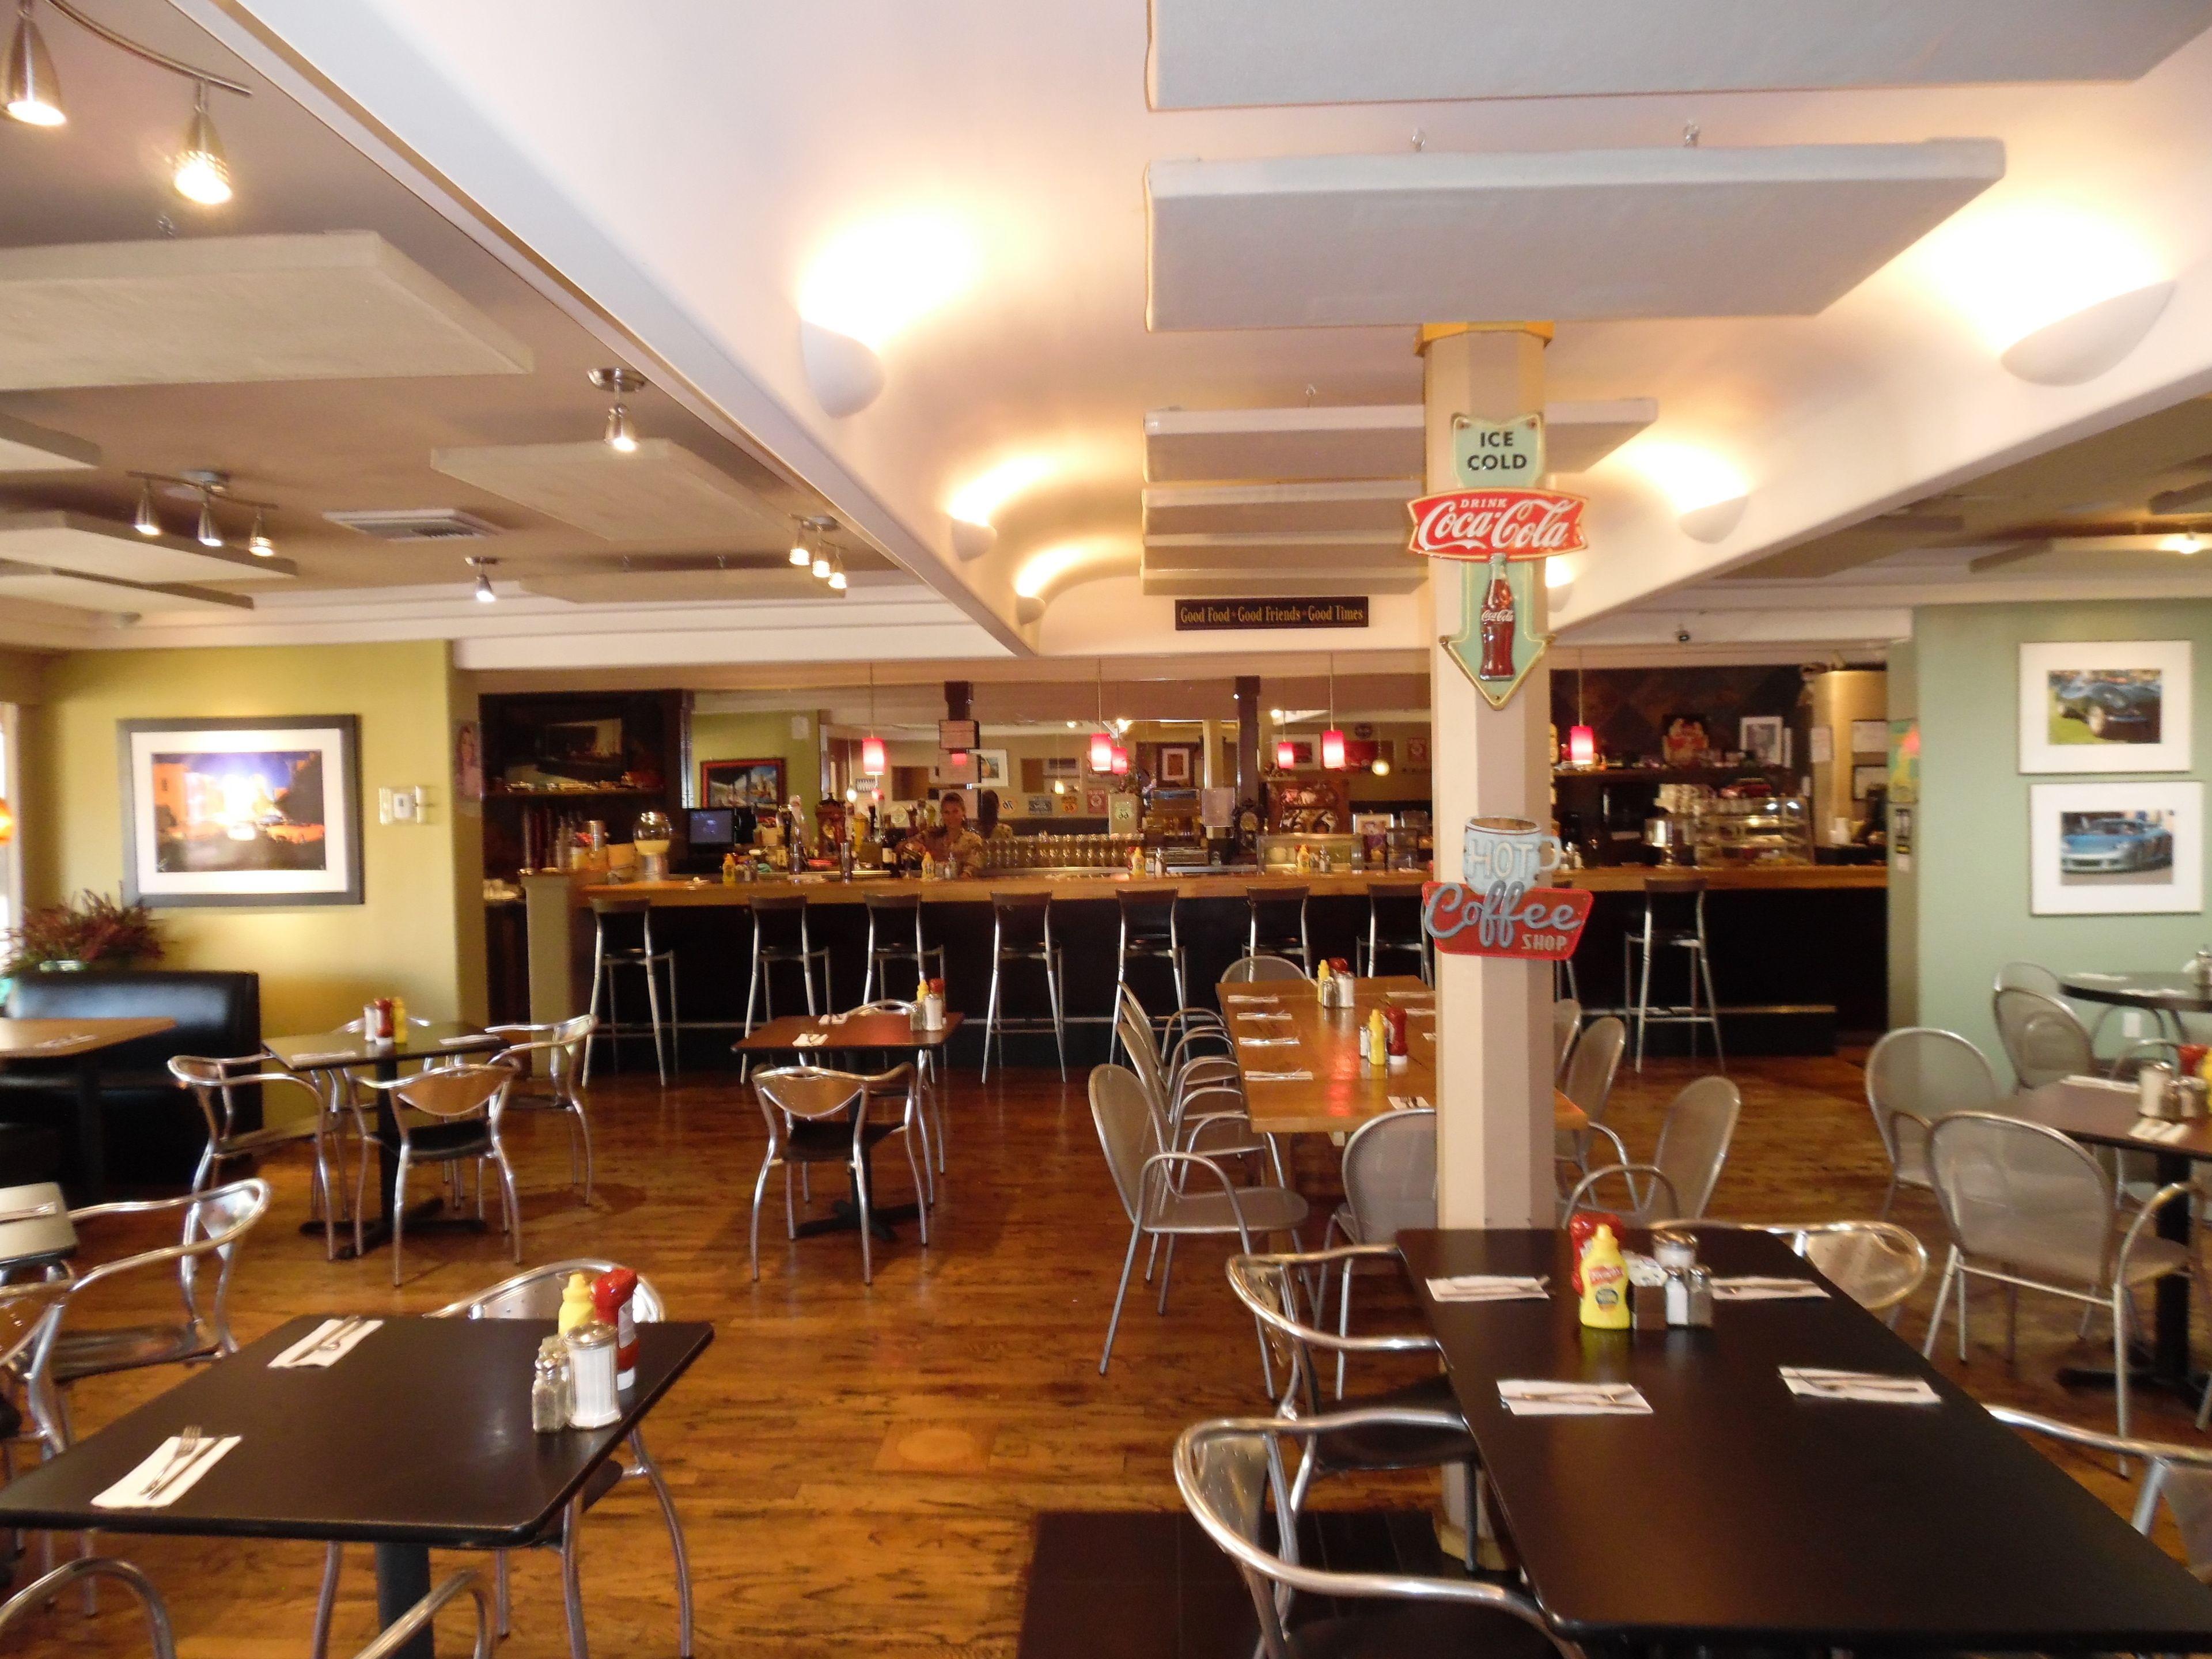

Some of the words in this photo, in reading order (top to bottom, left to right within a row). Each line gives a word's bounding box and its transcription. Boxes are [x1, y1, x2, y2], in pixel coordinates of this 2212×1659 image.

[1480, 431, 1514, 448] ICE
[1467, 454, 1528, 471] COLD
[1460, 498, 1508, 509] DRINK
[1417, 498, 1578, 551] Coca-Cola
[1181, 607, 1205, 623] Good
[1207, 607, 1230, 622] Food
[1238, 606, 1263, 623] Good
[1266, 605, 1301, 622] Friends
[1308, 605, 1332, 622] Good
[1336, 605, 1364, 620] Times
[1465, 839, 1534, 880] HOT
[1425, 880, 1582, 948] Coffee
[1521, 933, 1568, 952] SHOP
